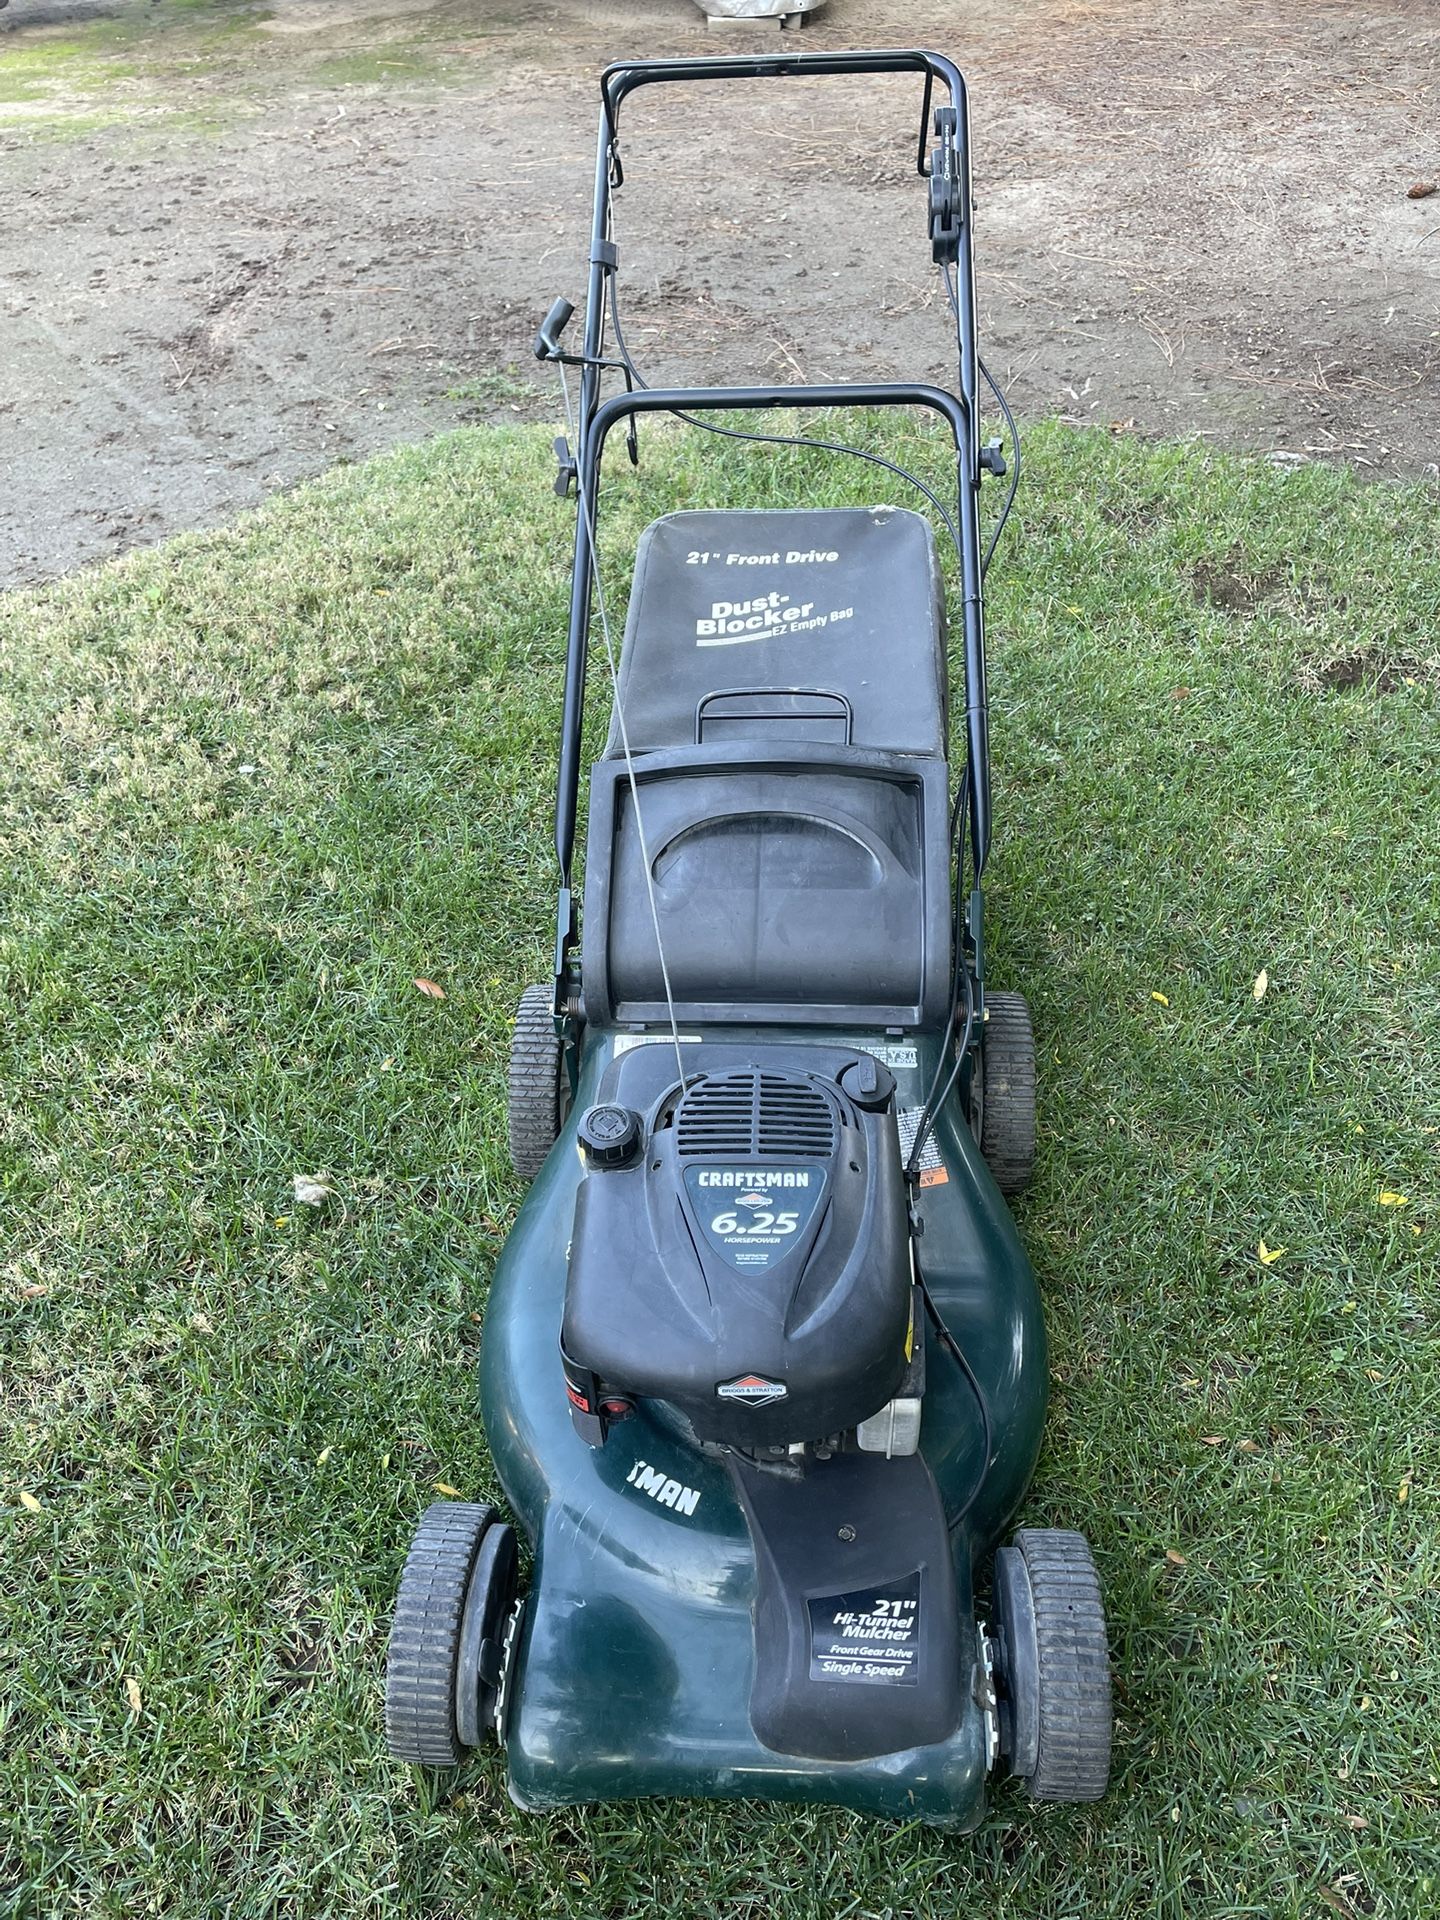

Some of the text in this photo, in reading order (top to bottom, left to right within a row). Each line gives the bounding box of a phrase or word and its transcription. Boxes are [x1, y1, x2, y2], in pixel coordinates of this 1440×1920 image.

[686, 550, 839, 565] 21" Front Drive
[712, 591, 790, 619] Dust-
[696, 602, 814, 635] Blocker
[772, 607, 854, 637] EZ Empty Bag
[698, 1172, 809, 1188] CRAFTSMAN
[711, 1212, 800, 1235] 6.25
[872, 1599, 917, 1617] 21"
[833, 1612, 914, 1629] Hi-Tunnel
[842, 1625, 911, 1641] Mulcher
[830, 1644, 913, 1658] Front Gear Drive
[821, 1661, 905, 1677] Single Speed
